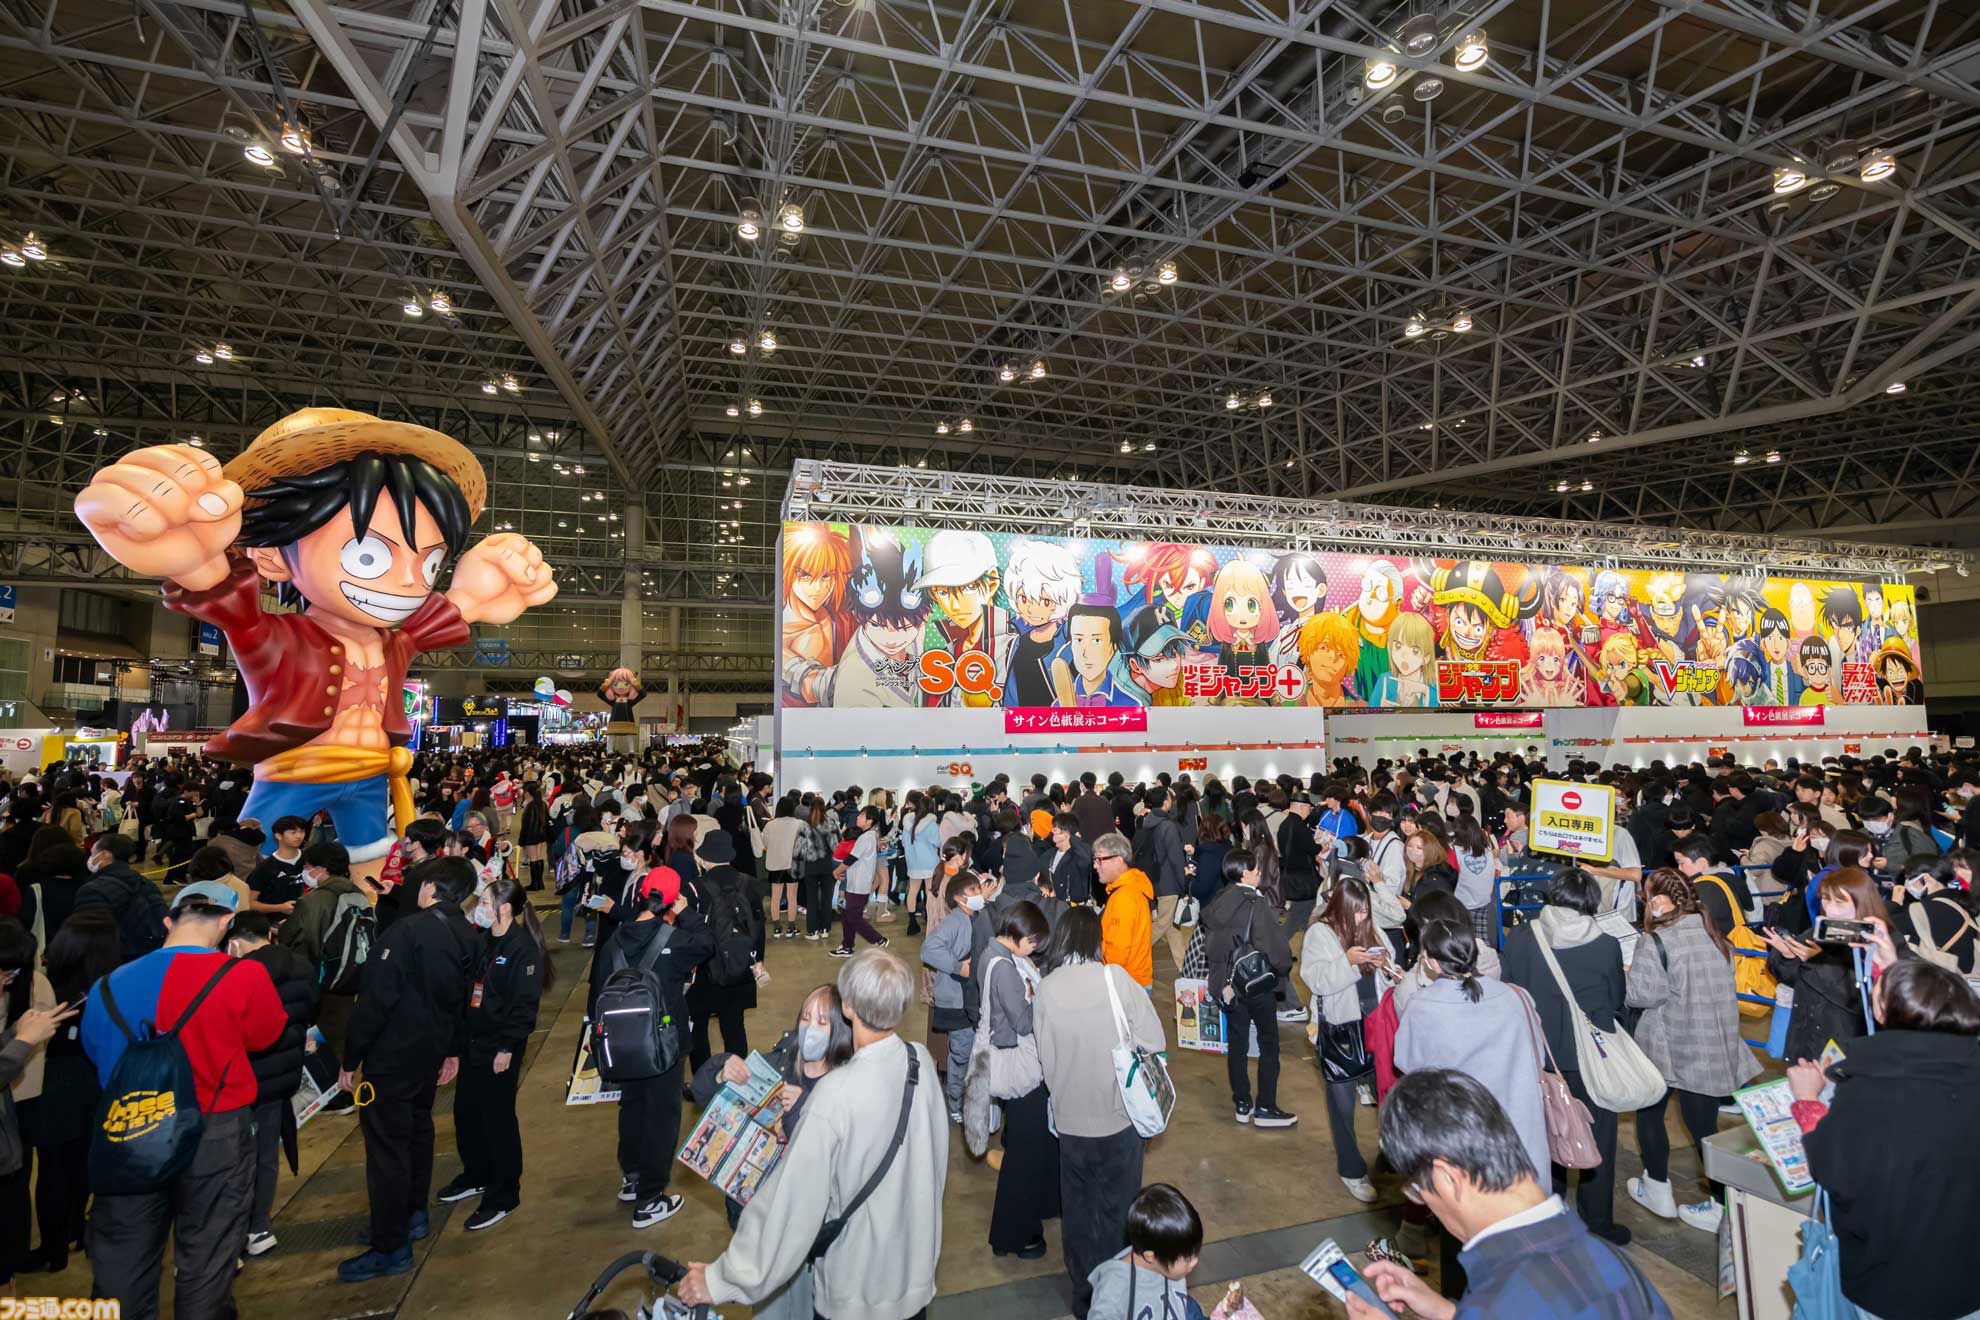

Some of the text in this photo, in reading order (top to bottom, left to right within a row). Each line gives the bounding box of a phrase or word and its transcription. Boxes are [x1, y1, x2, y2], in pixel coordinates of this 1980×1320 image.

[874, 657, 920, 674] ジャンプ
[1438, 661, 1520, 702] ジャンプ
[1013, 714, 1142, 728] サイン色紙展示コーナー
[1547, 816, 1594, 832] 入口専用
[1538, 830, 1604, 844] こちらは出口ではありません
